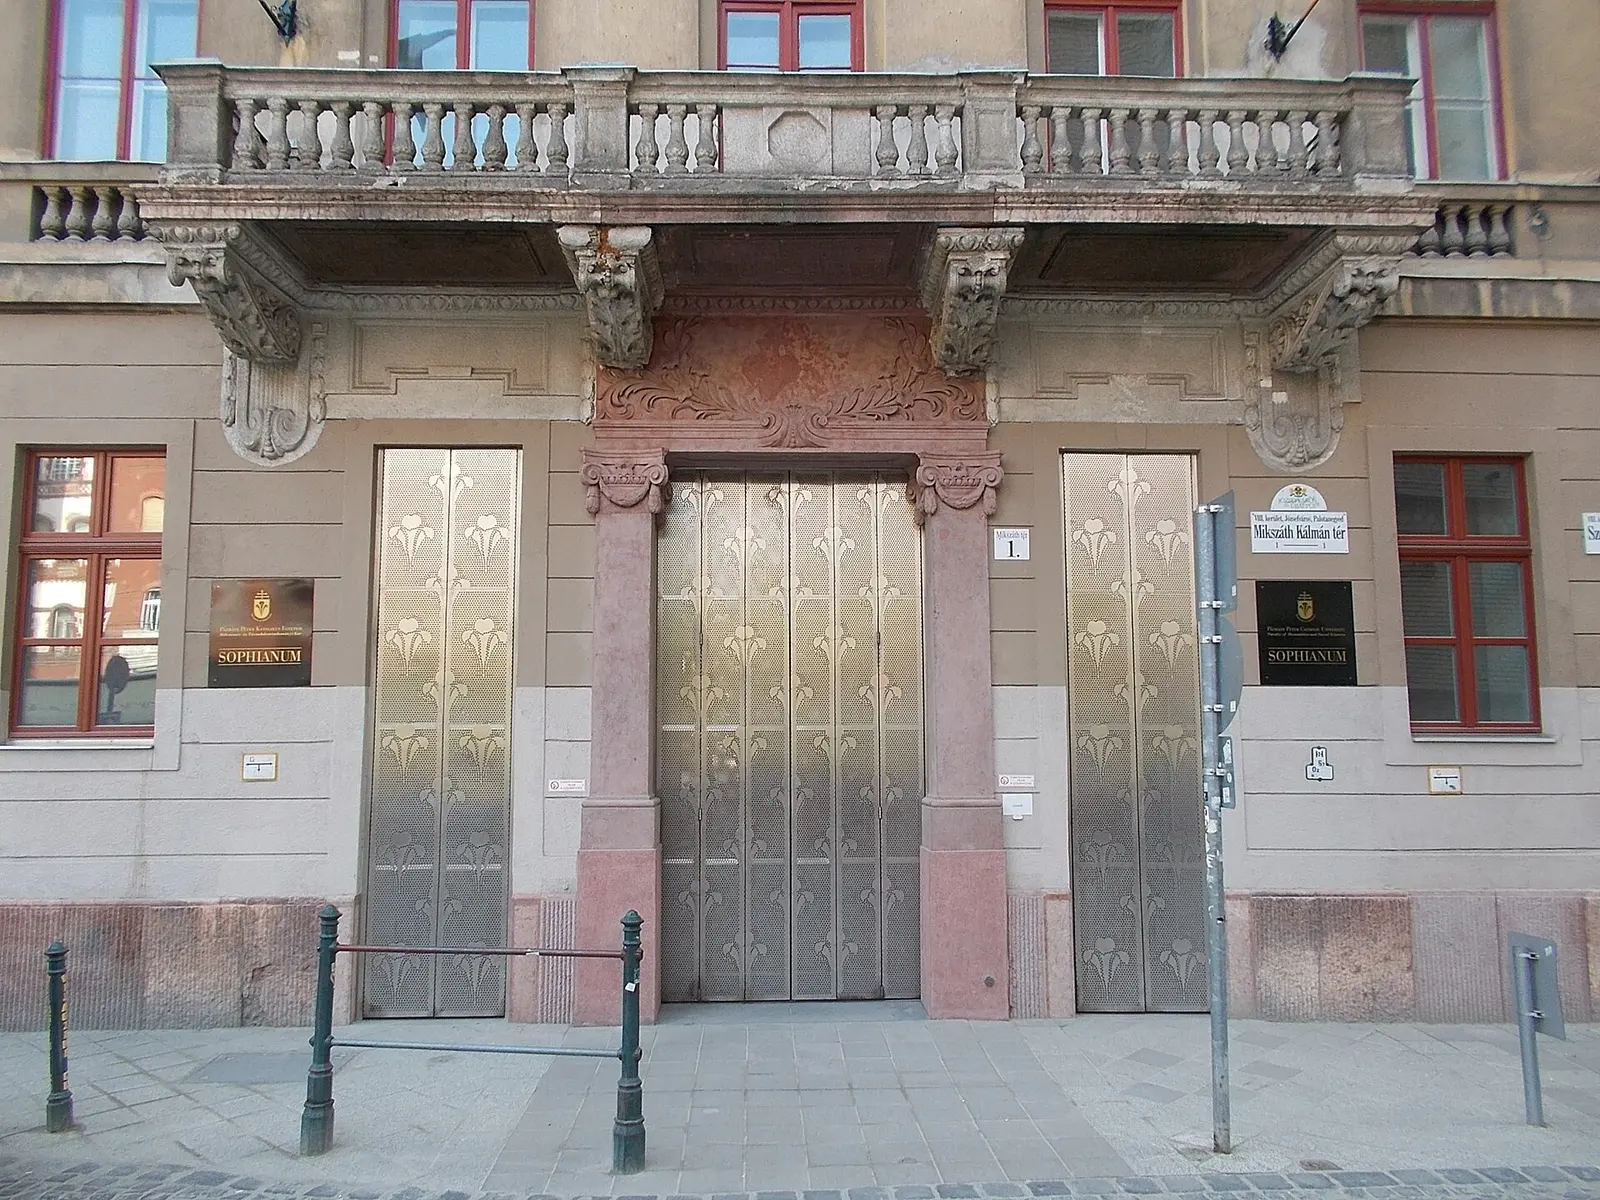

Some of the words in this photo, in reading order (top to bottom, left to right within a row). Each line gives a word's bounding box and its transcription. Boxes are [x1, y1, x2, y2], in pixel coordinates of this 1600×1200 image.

[1313, 514, 1344, 523] Palotanegyed
[1254, 524, 1294, 539] Mikszáth
[1296, 525, 1331, 540] Kálmán
[1332, 525, 1346, 540] tér
[1007, 540, 1020, 558] 1.
[218, 650, 302, 663] SOPHIANUM
[1268, 650, 1347, 662] SOPHIANUM
